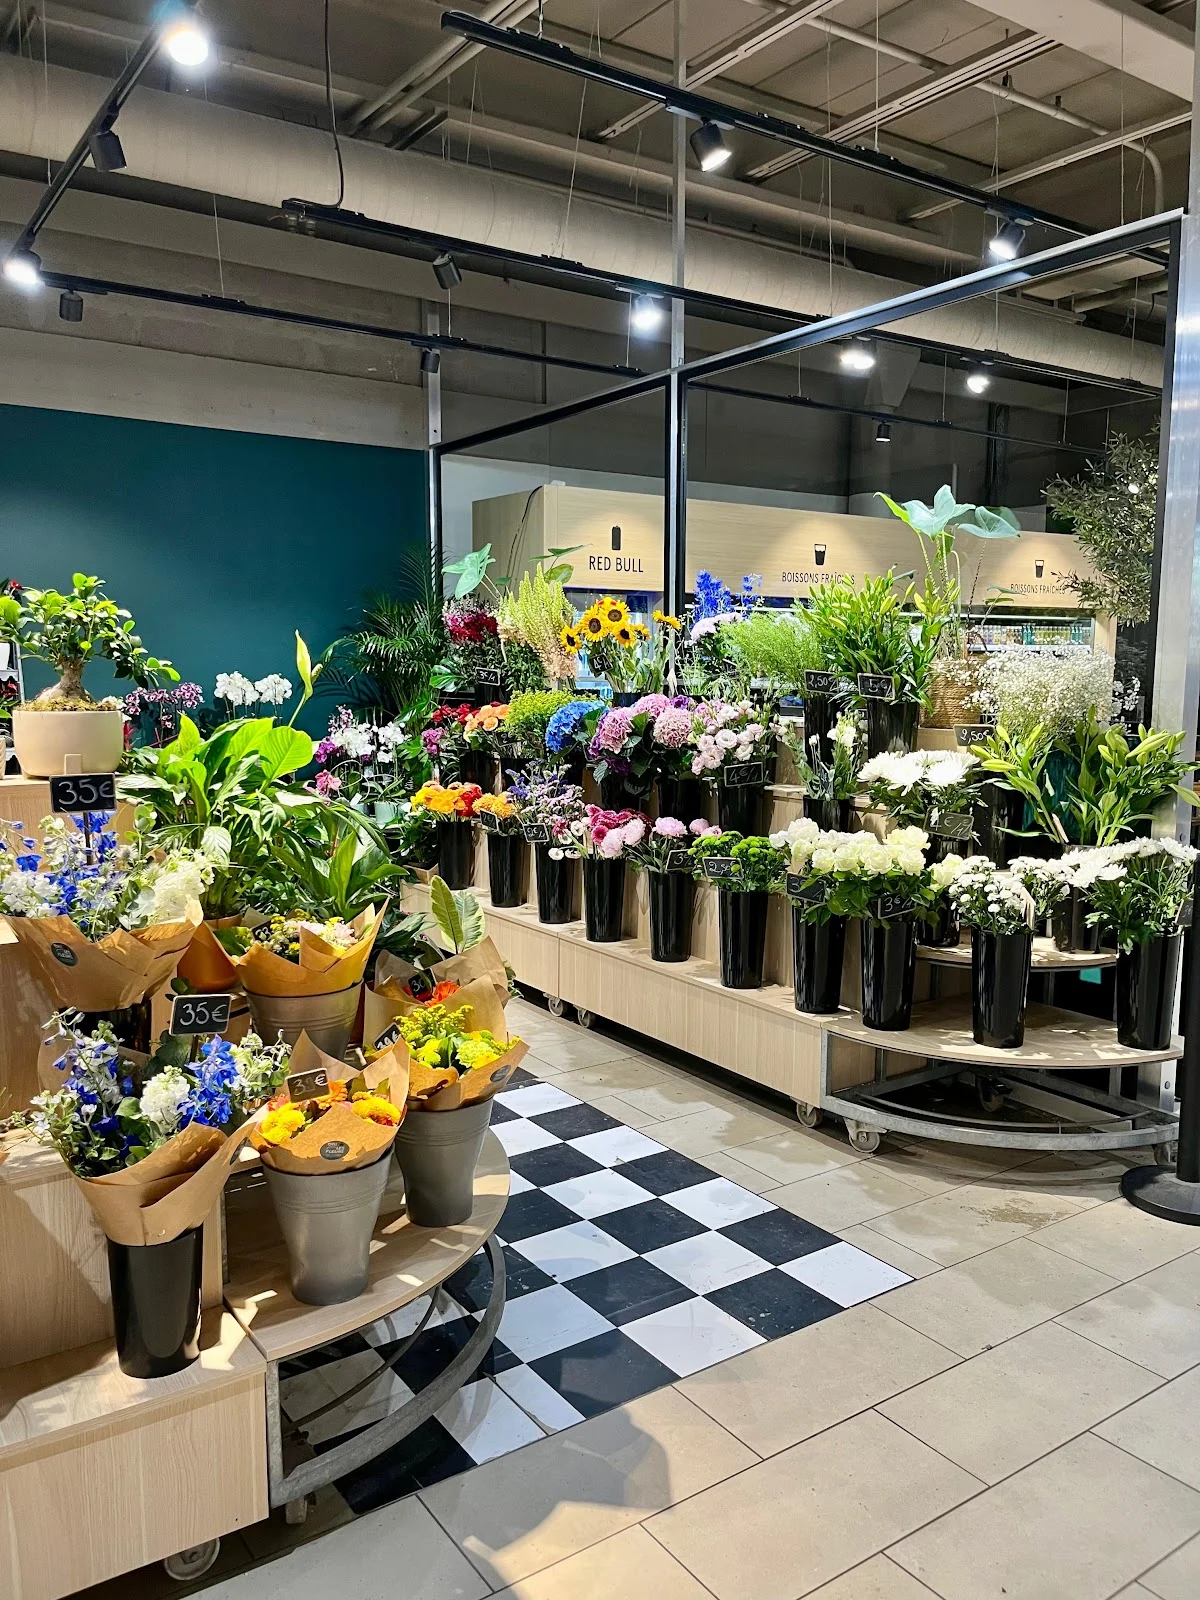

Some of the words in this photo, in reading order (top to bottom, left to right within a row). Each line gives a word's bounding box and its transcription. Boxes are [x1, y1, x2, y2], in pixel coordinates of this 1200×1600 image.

[589, 555, 611, 571] RED
[616, 557, 644, 573] BULL
[782, 571, 819, 584] BOISSONS
[821, 571, 855, 585] FRAÎCS
[1010, 583, 1038, 594] BOISSONS
[58, 778, 116, 805] 35€
[180, 1001, 229, 1026] 35€
